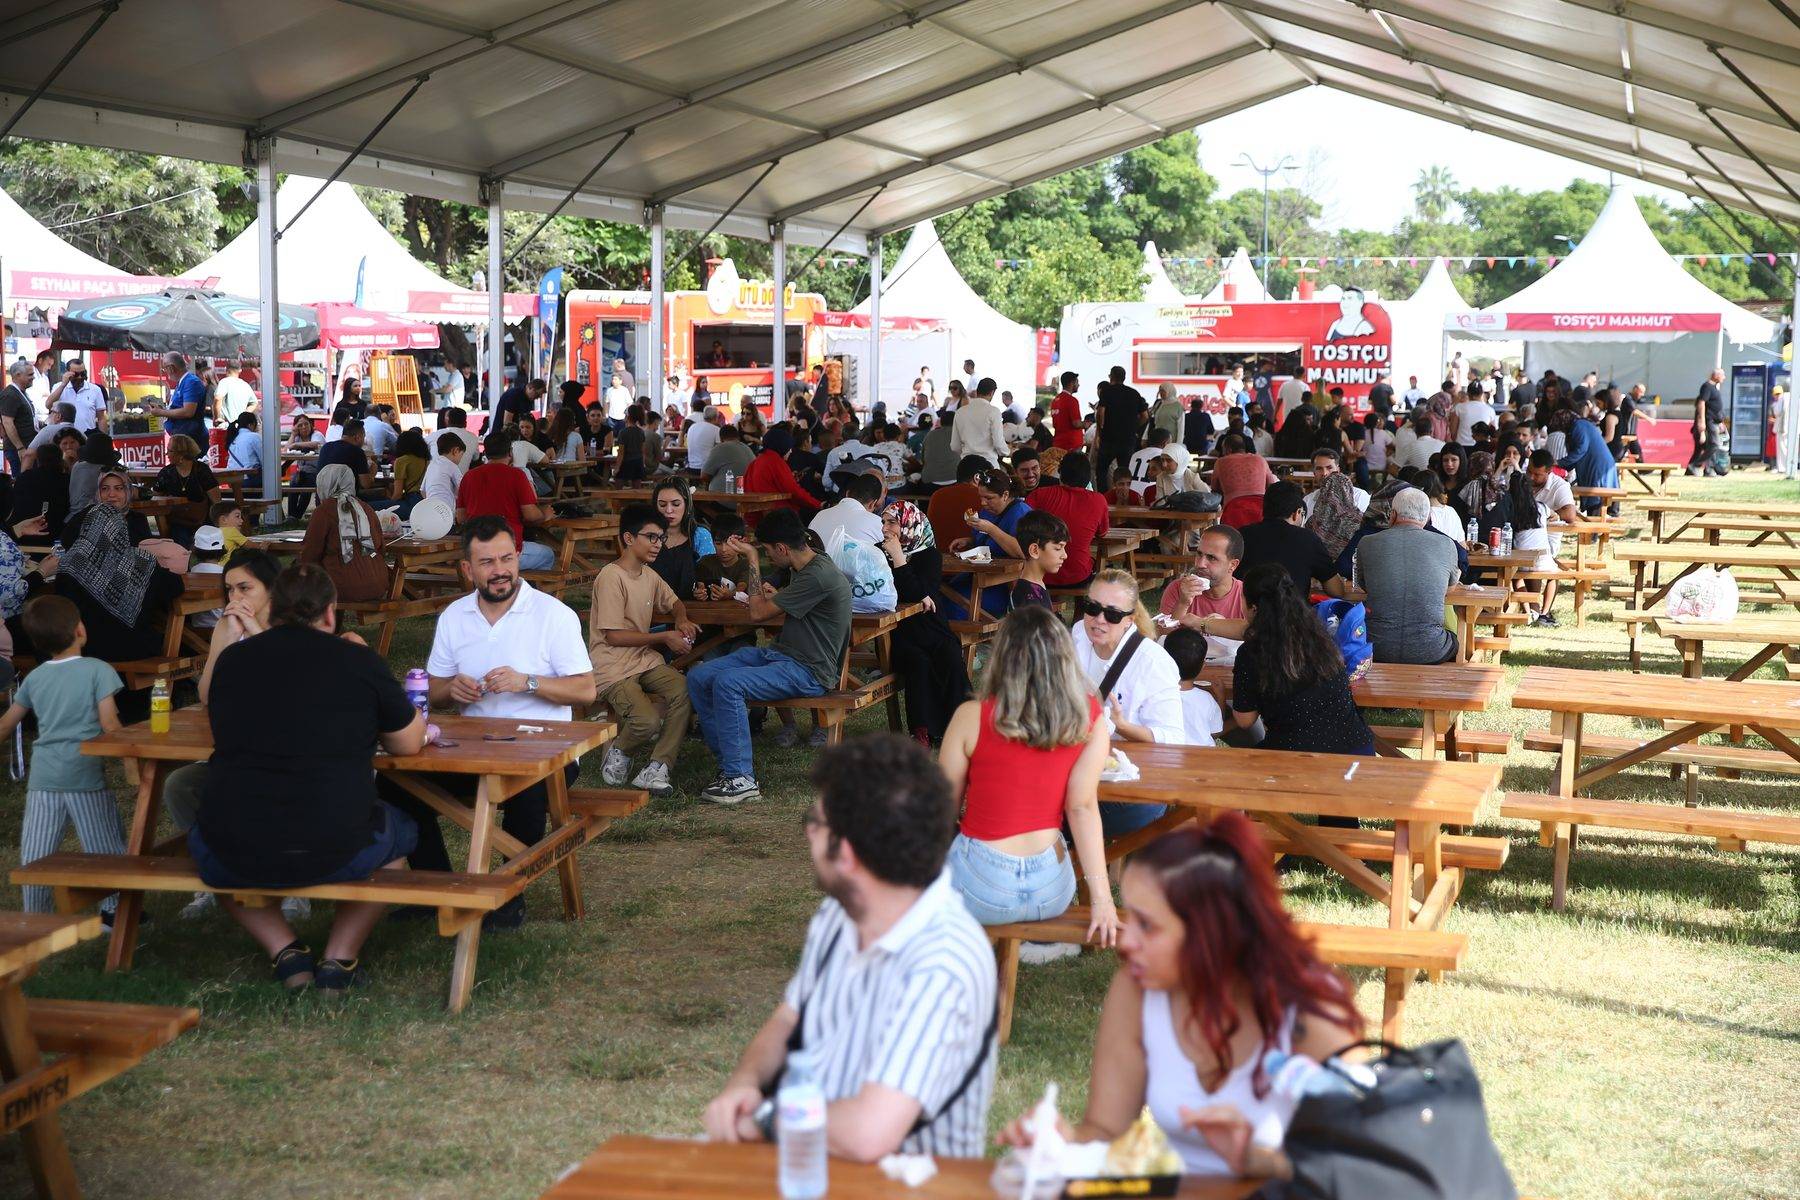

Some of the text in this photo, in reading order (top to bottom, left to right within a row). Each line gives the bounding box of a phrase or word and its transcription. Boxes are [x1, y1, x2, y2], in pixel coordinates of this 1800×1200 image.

[1553, 315, 1673, 329] TOSTÇU MAHMUT
[1312, 344, 1388, 364] TOSTÇU
